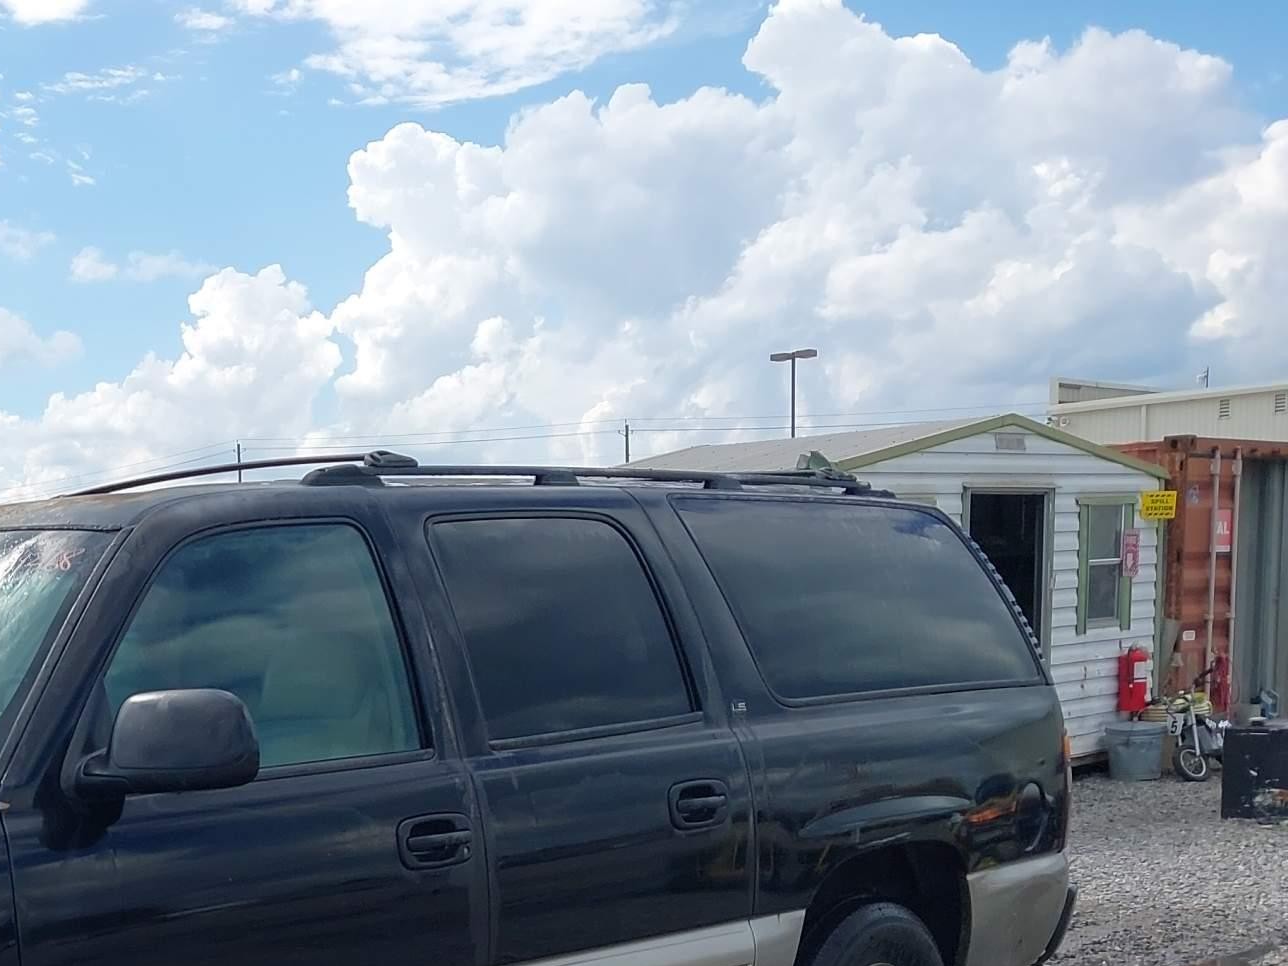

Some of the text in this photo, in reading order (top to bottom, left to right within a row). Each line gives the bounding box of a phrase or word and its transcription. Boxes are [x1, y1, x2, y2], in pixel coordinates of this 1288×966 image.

[1216, 521, 1230, 535] AL
[731, 702, 746, 711] LS
[1170, 720, 1177, 733] 5
